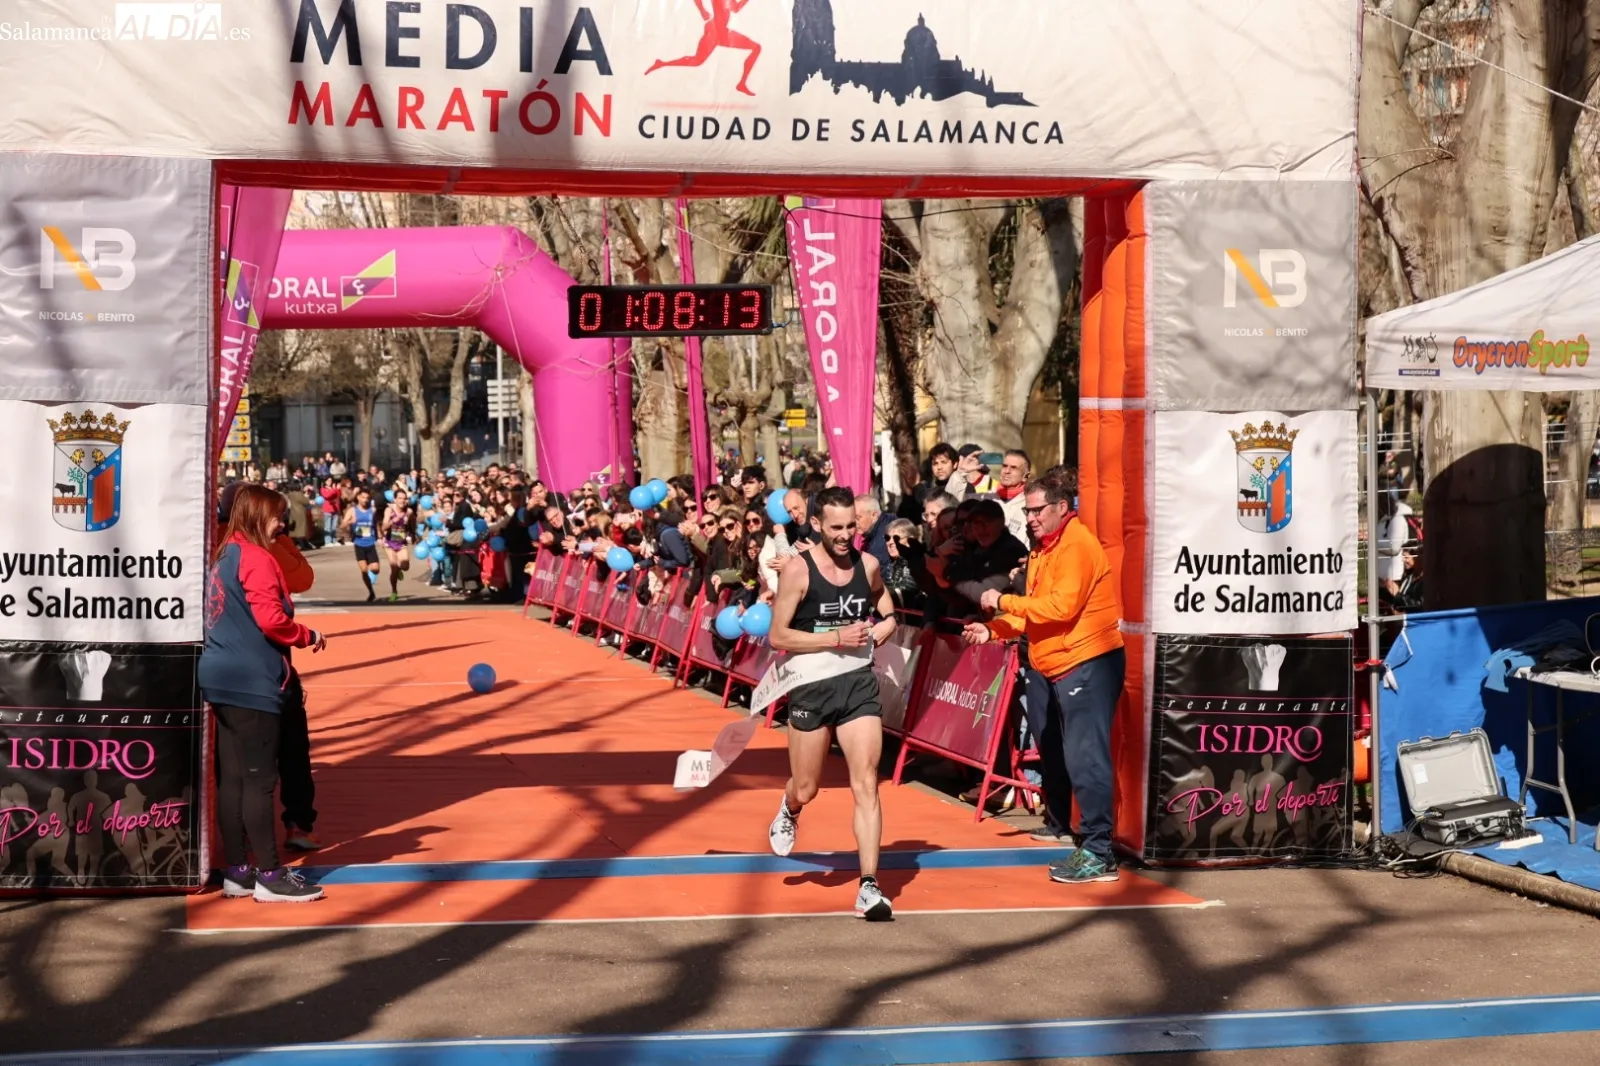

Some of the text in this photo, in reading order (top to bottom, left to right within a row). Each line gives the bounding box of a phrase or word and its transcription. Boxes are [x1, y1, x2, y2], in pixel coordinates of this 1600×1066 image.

[290, 0, 613, 76] MEDIA
[288, 78, 612, 137] MARATÓN
[638, 114, 1064, 145] CIUDAD DE SALAMANCA
[39, 311, 84, 321] NICOLAS
[97, 312, 135, 322] BENITO
[285, 301, 337, 314] kutxa
[1224, 328, 1264, 337] NICOLAS
[1275, 328, 1308, 337] BENITO
[1174, 545, 1343, 580] Ayuntamiento
[27, 586, 185, 620] Salamanca
[1174, 585, 1344, 613] de Salamanca
[928, 677, 959, 705] LABORAL
[1167, 699, 1347, 712] restaurante
[6, 737, 156, 779] ISIDRO
[1196, 724, 1323, 762] ISIDRO
[1167, 781, 1346, 833] Por el deporte
[0, 800, 189, 857] Por el deporte
